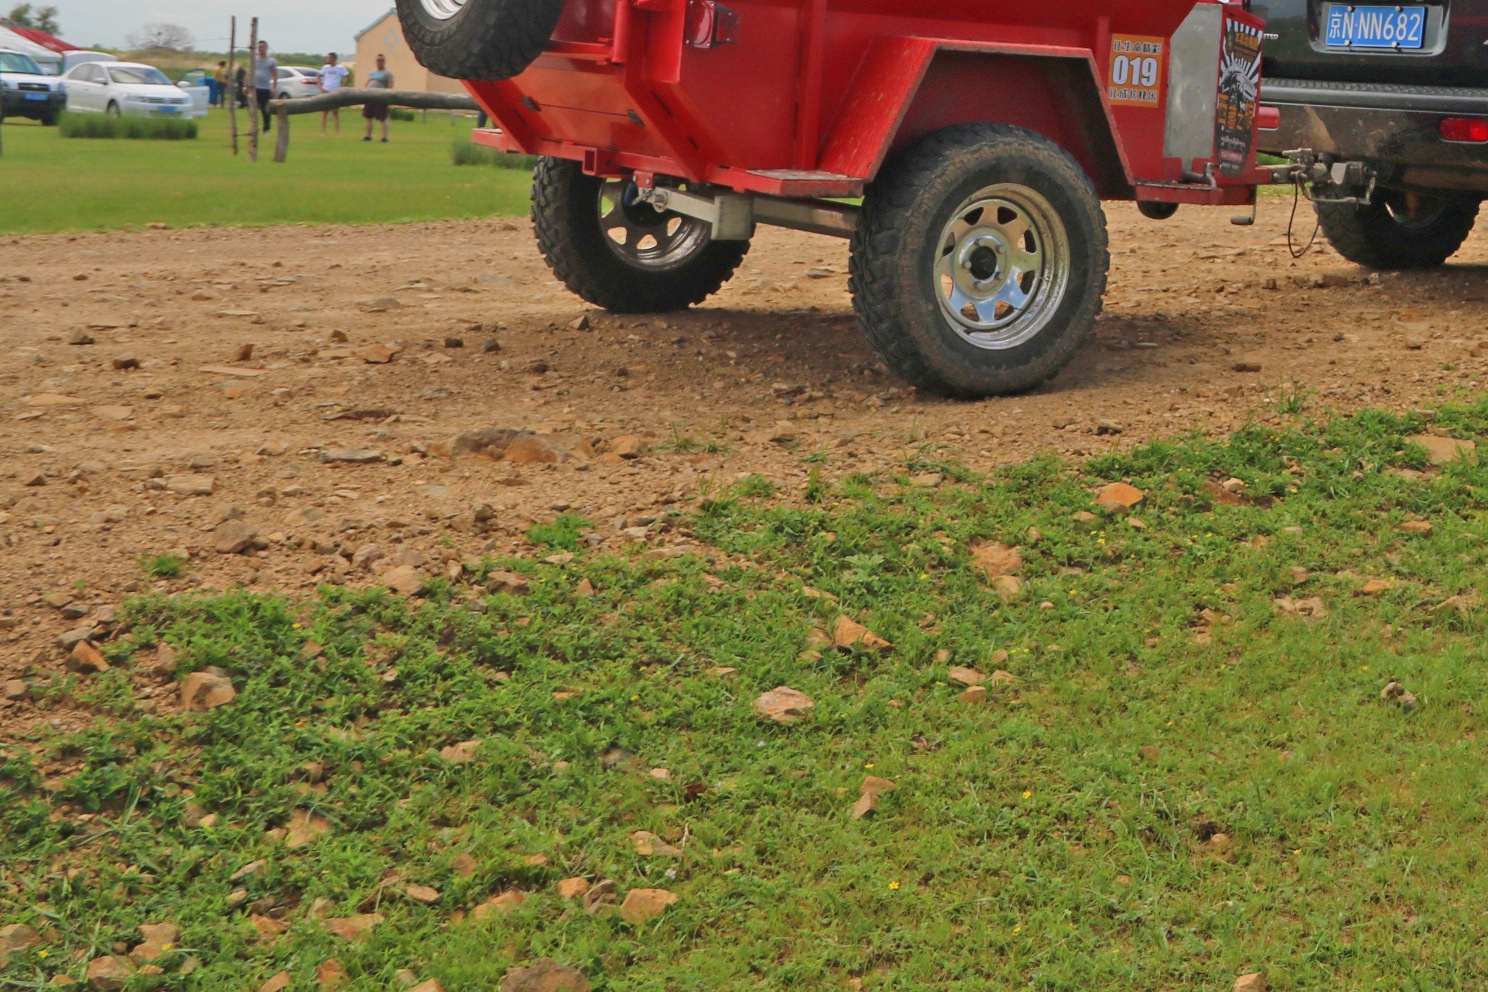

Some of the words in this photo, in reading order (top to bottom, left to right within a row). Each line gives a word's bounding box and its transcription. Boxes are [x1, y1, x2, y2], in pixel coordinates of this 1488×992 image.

[1329, 11, 1421, 41] 京N·NN682
[1113, 40, 1162, 54] 让生命精彩
[1112, 55, 1158, 87] 019
[1109, 87, 1158, 102] 让成长快乐
